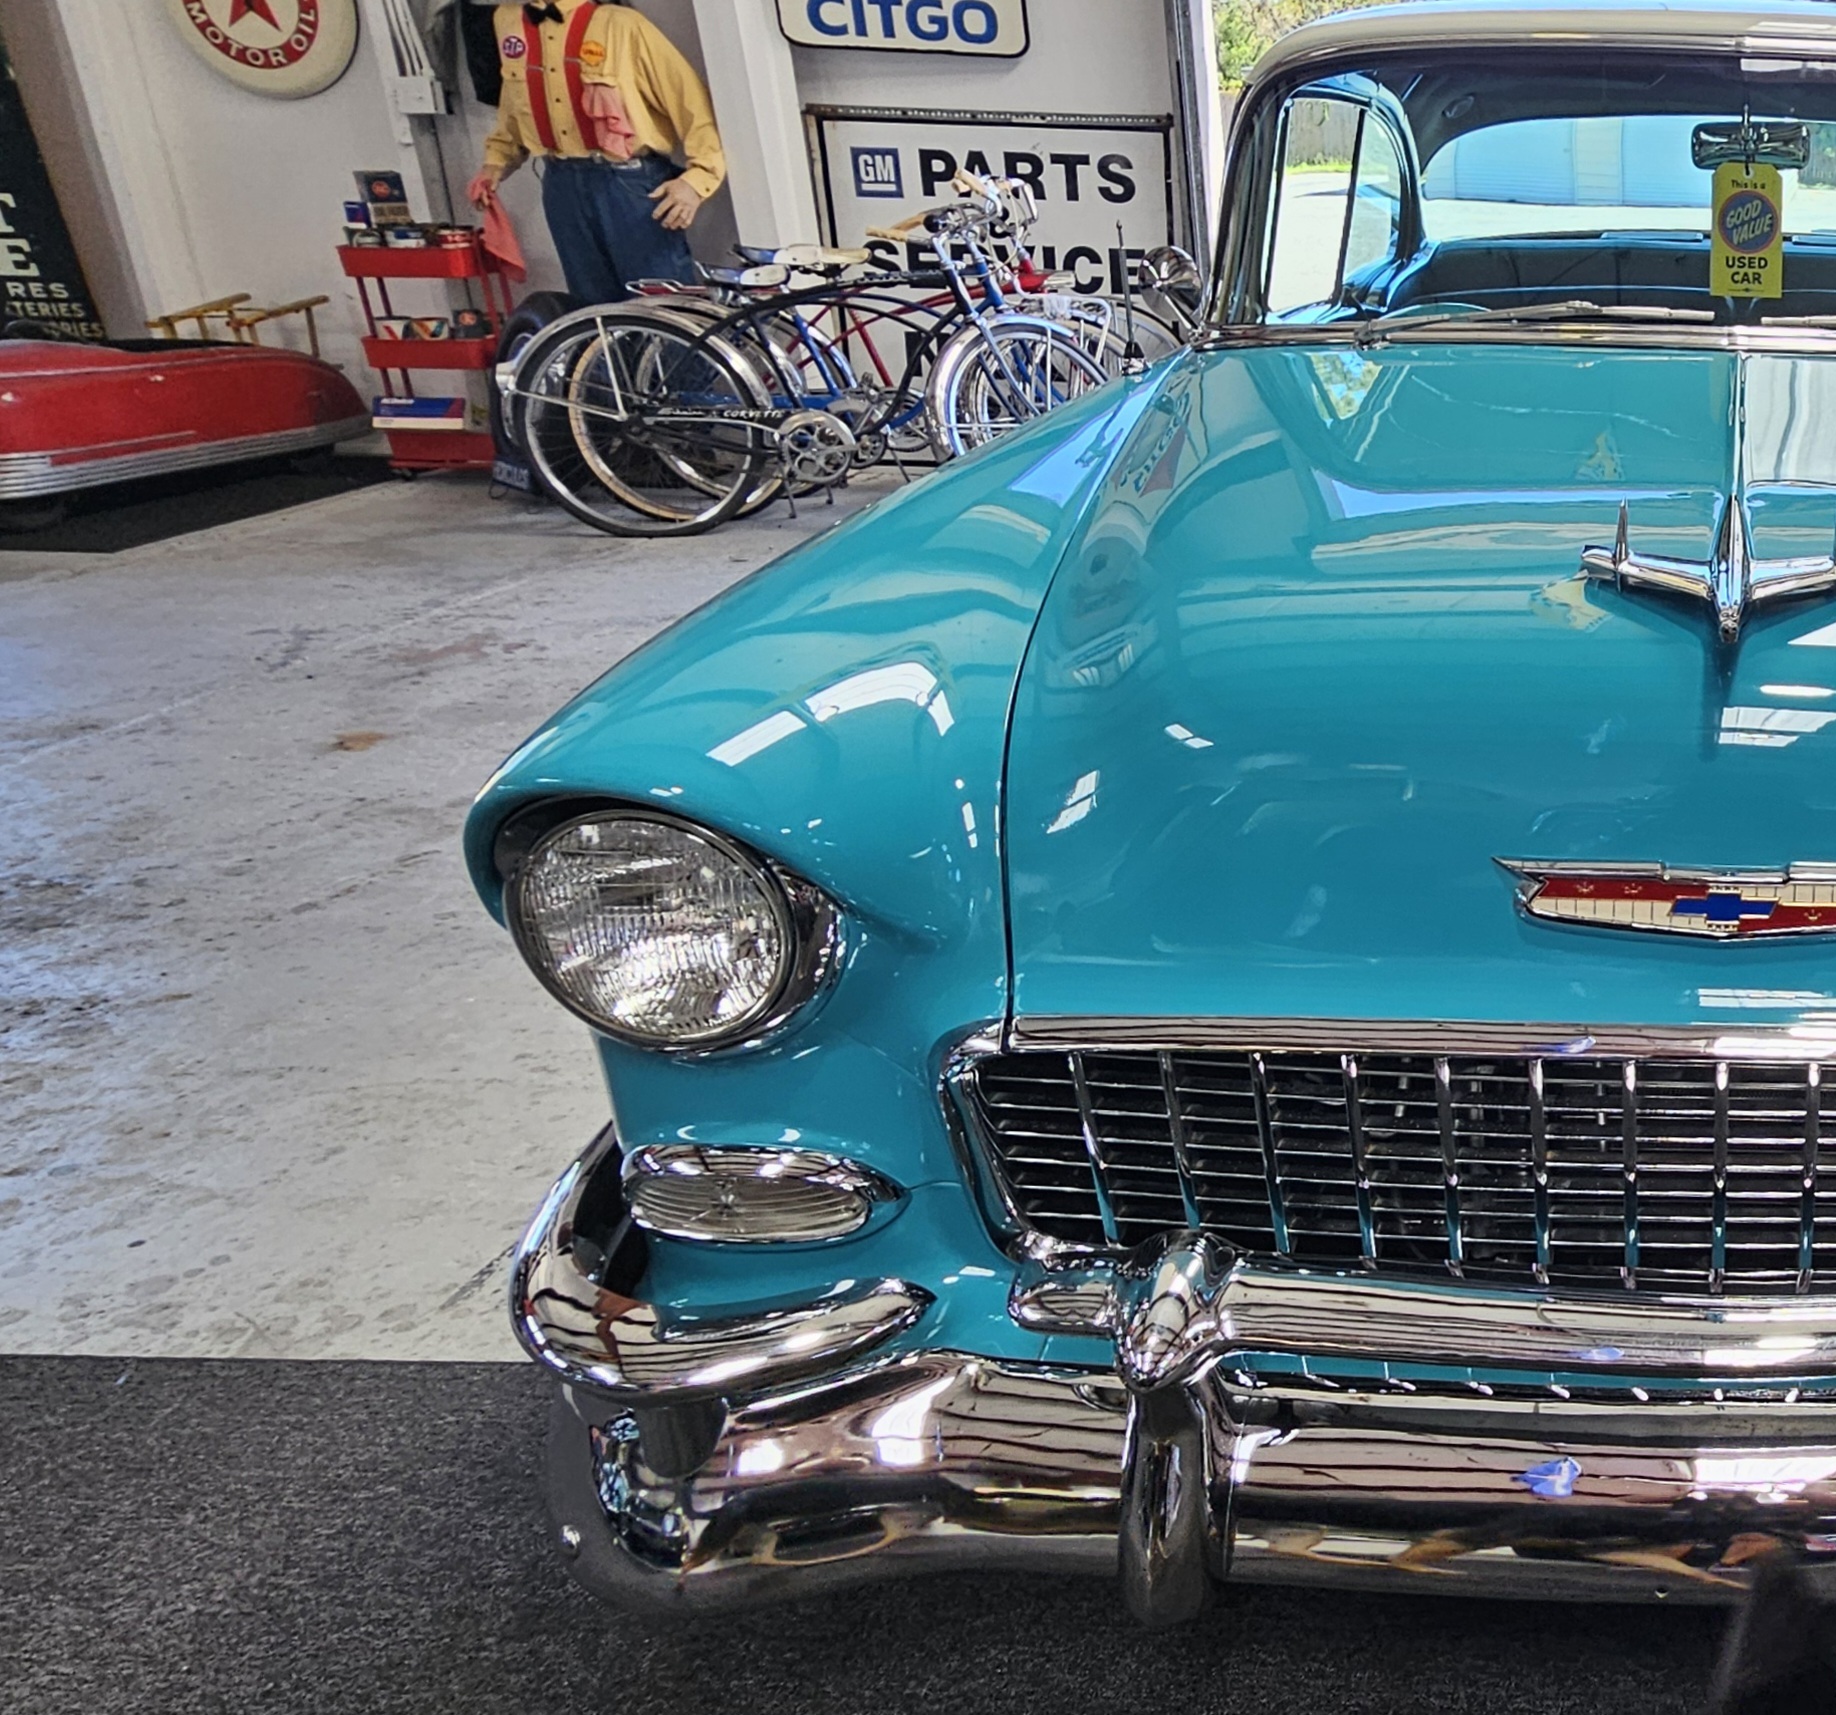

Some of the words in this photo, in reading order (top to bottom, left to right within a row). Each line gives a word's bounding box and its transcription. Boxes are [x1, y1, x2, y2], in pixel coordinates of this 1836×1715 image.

[186, 2, 288, 66] MOTOR
[290, 9, 315, 52] OIL
[806, 0, 999, 45] CITGO
[858, 153, 896, 183] GM
[918, 148, 1136, 203] PARTS
[1731, 179, 1748, 189] This
[1750, 180, 1758, 189] is
[1726, 200, 1762, 228] GOOD
[1732, 213, 1773, 245] VALUE
[1725, 256, 1768, 269] USED
[1730, 272, 1762, 285] CAR
